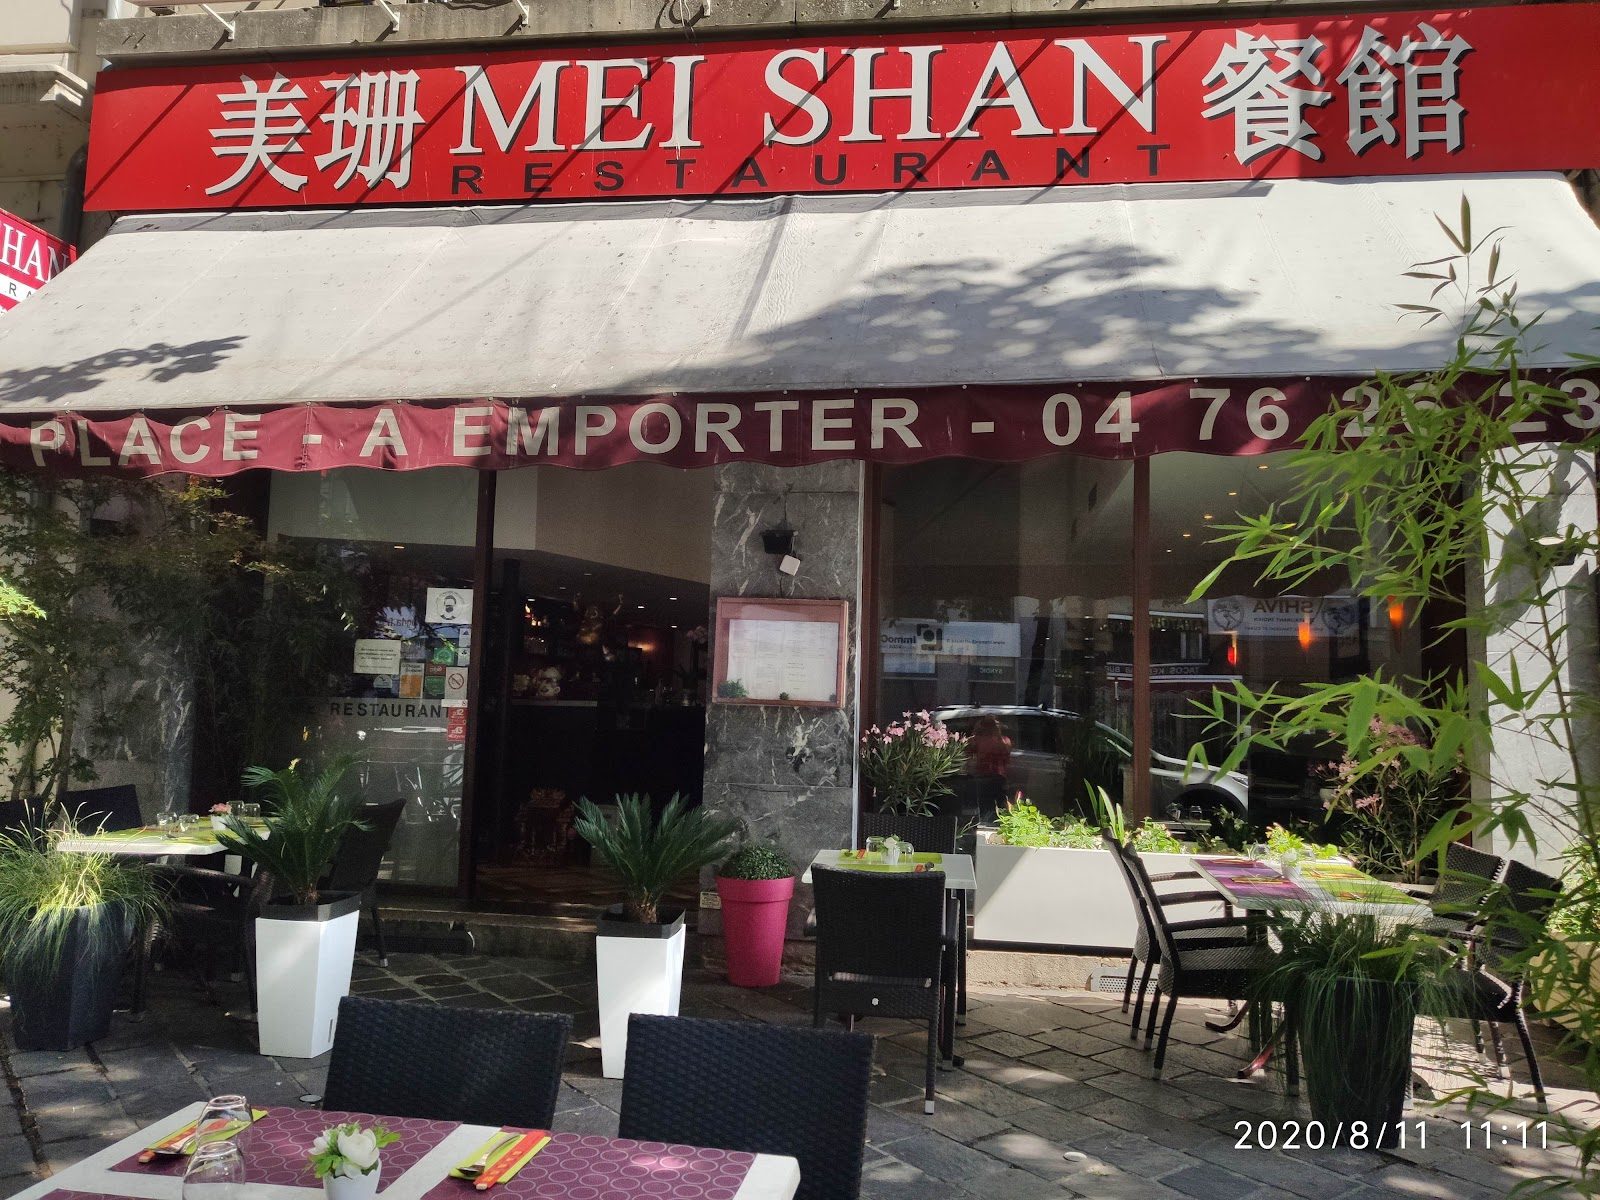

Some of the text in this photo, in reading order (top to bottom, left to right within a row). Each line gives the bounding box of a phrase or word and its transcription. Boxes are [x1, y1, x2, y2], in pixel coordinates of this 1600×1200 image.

[205, 68, 426, 195] 美珊
[449, 34, 1168, 156] MEI SHAN
[1201, 21, 1473, 166] 餐館
[451, 144, 1171, 195] RESTAURANT
[30, 412, 260, 467] PLACE
[360, 408, 408, 457] A
[452, 396, 922, 458] EMPORTER
[1042, 392, 1140, 446] 04
[1189, 387, 1290, 441] 76
